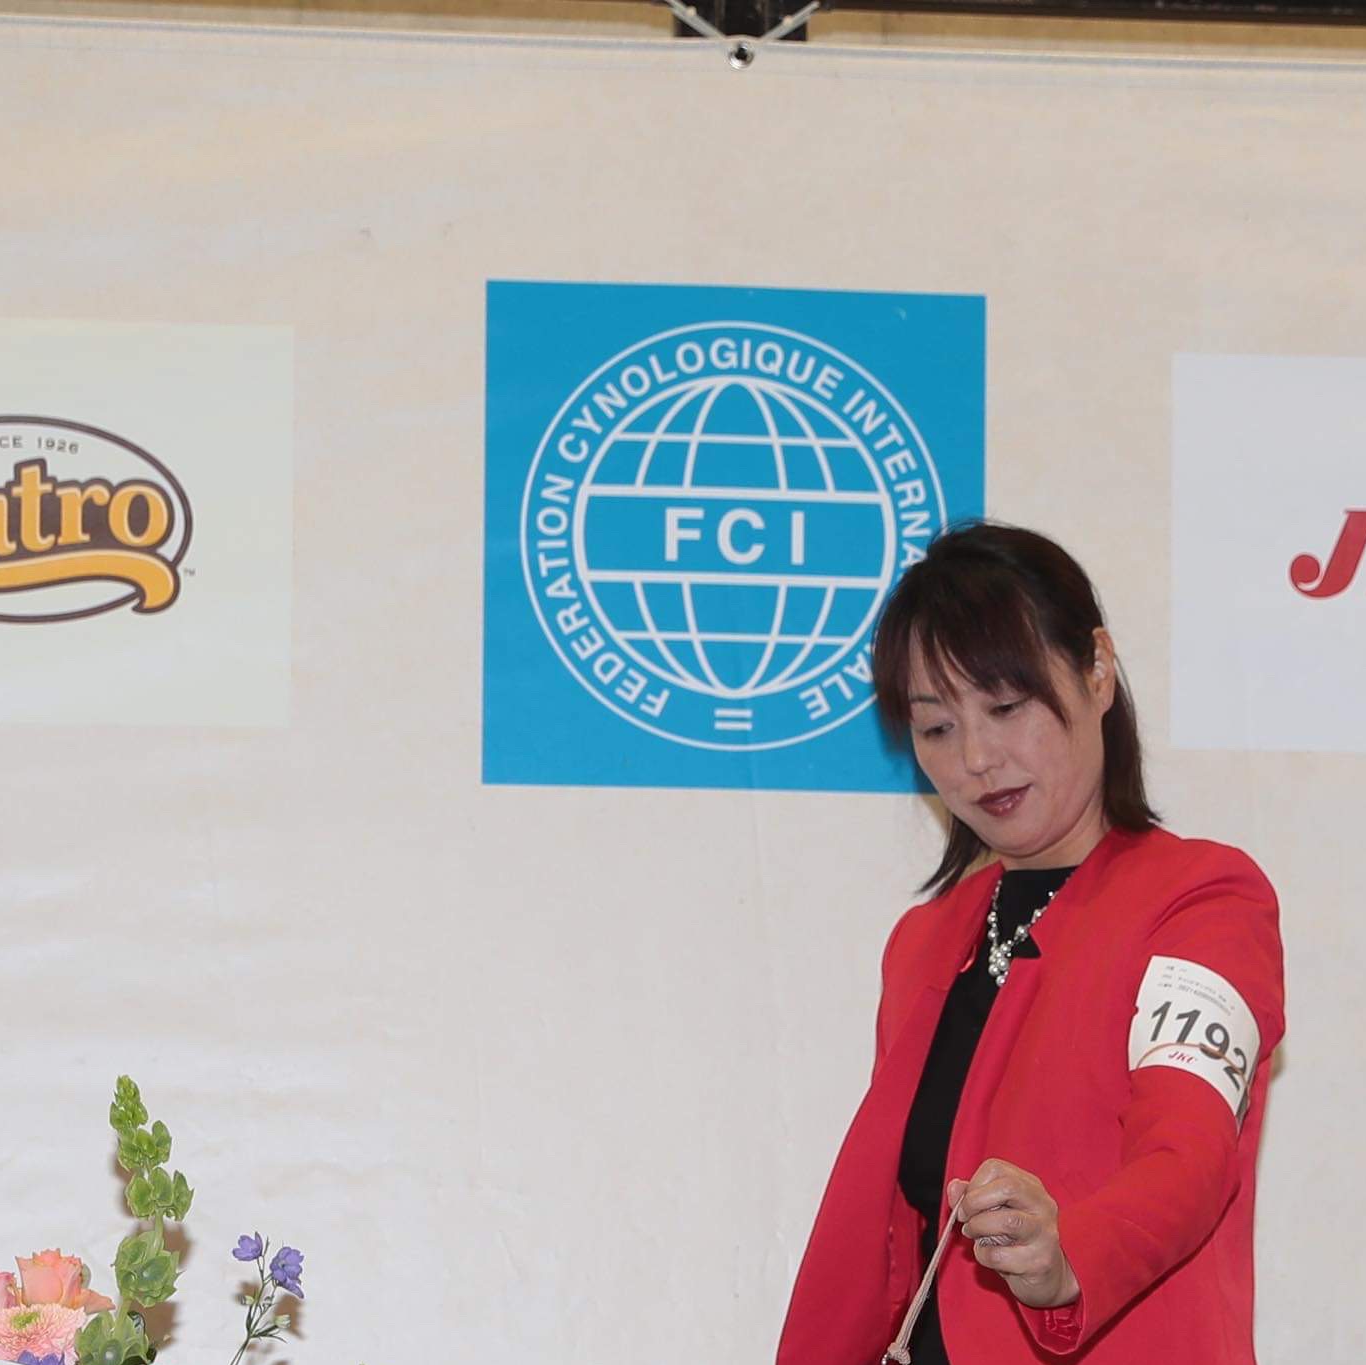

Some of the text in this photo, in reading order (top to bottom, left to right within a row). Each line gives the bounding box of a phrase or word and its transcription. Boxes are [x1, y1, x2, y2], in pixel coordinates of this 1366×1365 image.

[36, 435, 80, 455] 1926
[536, 337, 933, 720] FEDERATION CYNOLOGIQUE INTERNAALE
[664, 507, 806, 565] FCI
[1150, 1001, 1247, 1091] 1192
[1167, 1051, 1198, 1065] JKC
